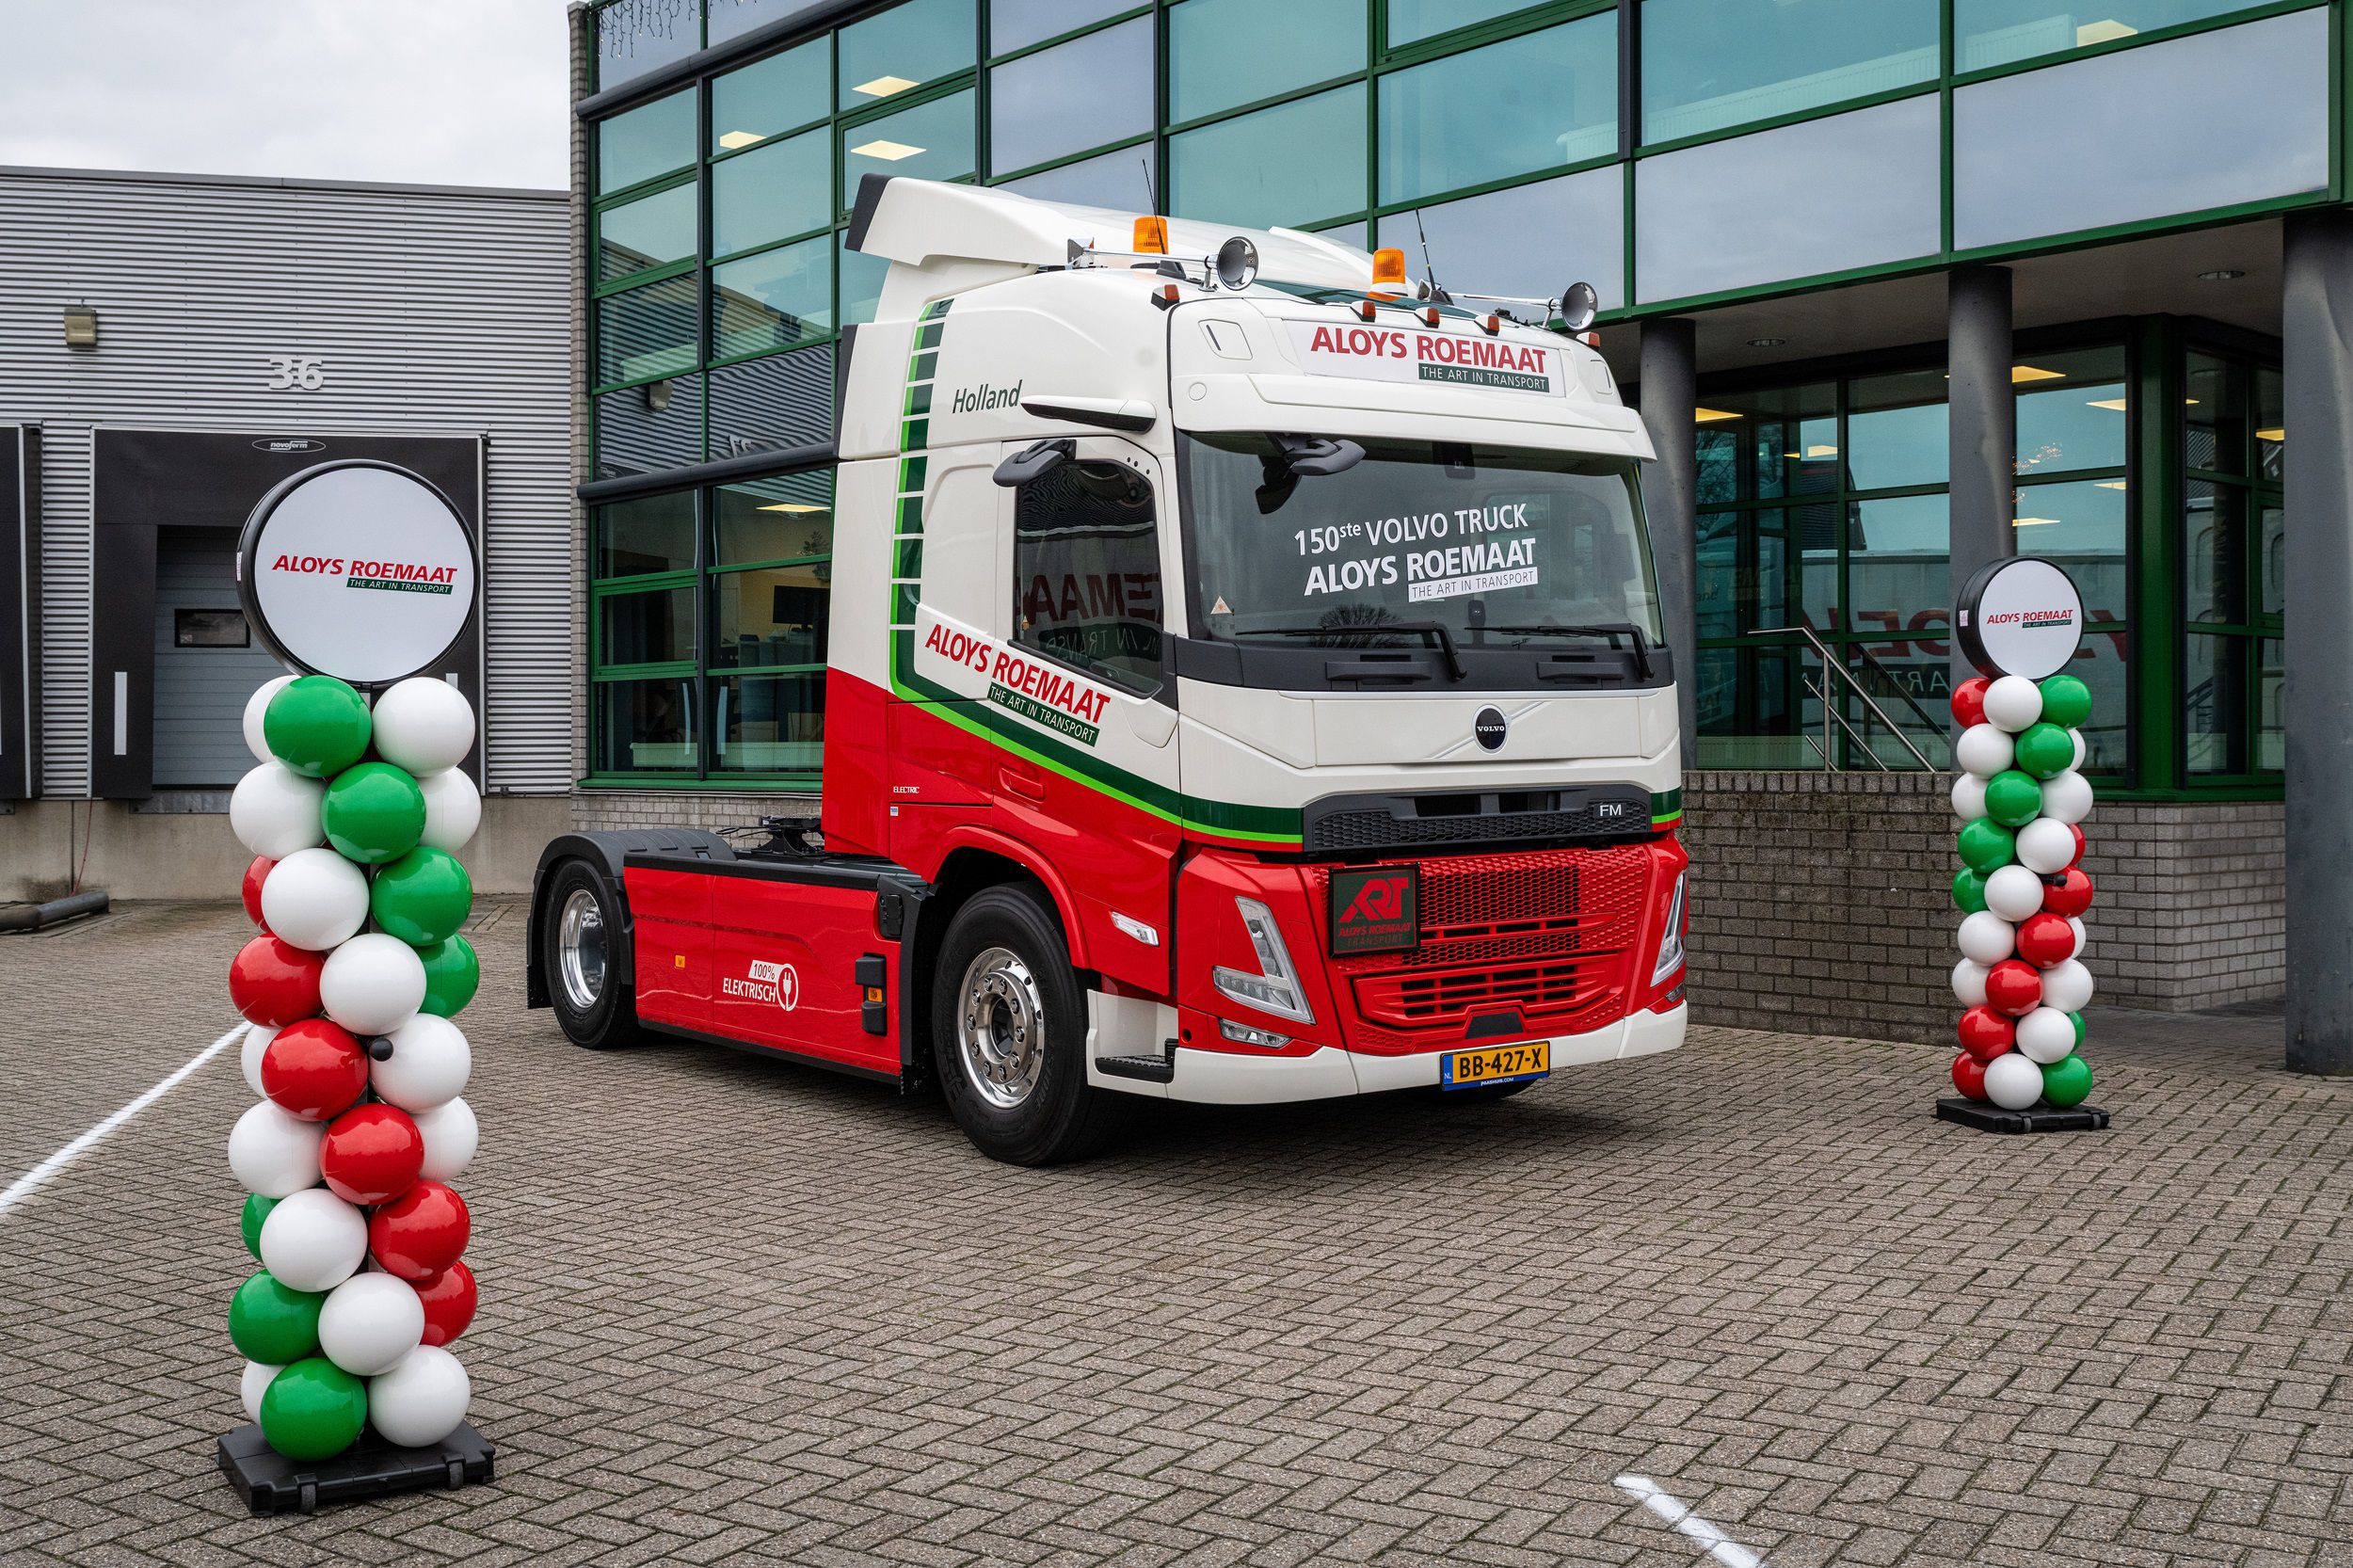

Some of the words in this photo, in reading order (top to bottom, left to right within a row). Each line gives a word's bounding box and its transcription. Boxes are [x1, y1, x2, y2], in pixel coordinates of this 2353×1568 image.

[1310, 327, 1407, 359] ALOYS
[1417, 335, 1546, 373] ROEMAAT
[268, 355, 324, 391] 36
[1422, 367, 1443, 379] THE
[1448, 369, 1467, 382] ART
[1472, 372, 1483, 383] IN
[1487, 374, 1545, 390] TRANSPORT
[952, 379, 1022, 413] Holland
[270, 440, 309, 450] novoform
[1294, 522, 1362, 555] 150ste
[1365, 513, 1449, 546] VOLVO
[1454, 504, 1529, 535] TRUCK
[272, 555, 344, 575] ALOYS
[350, 561, 457, 583] ROEMAAT
[1304, 555, 1399, 596] ALOYS
[1406, 537, 1536, 581] ROEMAAT
[350, 579, 366, 587] THE
[369, 581, 386, 589] ART
[401, 583, 449, 593] TRANSPORT
[1412, 584, 1432, 598] THE
[1437, 583, 1456, 595] ART
[1461, 580, 1472, 592] IN
[1476, 571, 1534, 589] TRANSPORT
[1987, 614, 2020, 624] ALOYS
[2023, 610, 2073, 621] ROEMAAT
[925, 624, 992, 673] ALOYS
[992, 651, 1111, 724] ROEMAAT
[990, 686, 1005, 704] THE
[1008, 697, 1026, 712] ART
[1028, 704, 1036, 717] IN
[1040, 709, 1095, 743] TRANSPORT
[1600, 805, 1622, 816] FM
[754, 964, 775, 980] 100%
[723, 978, 776, 1002] ELEKTRISCH
[1460, 1048, 1542, 1078] BB-427-X
